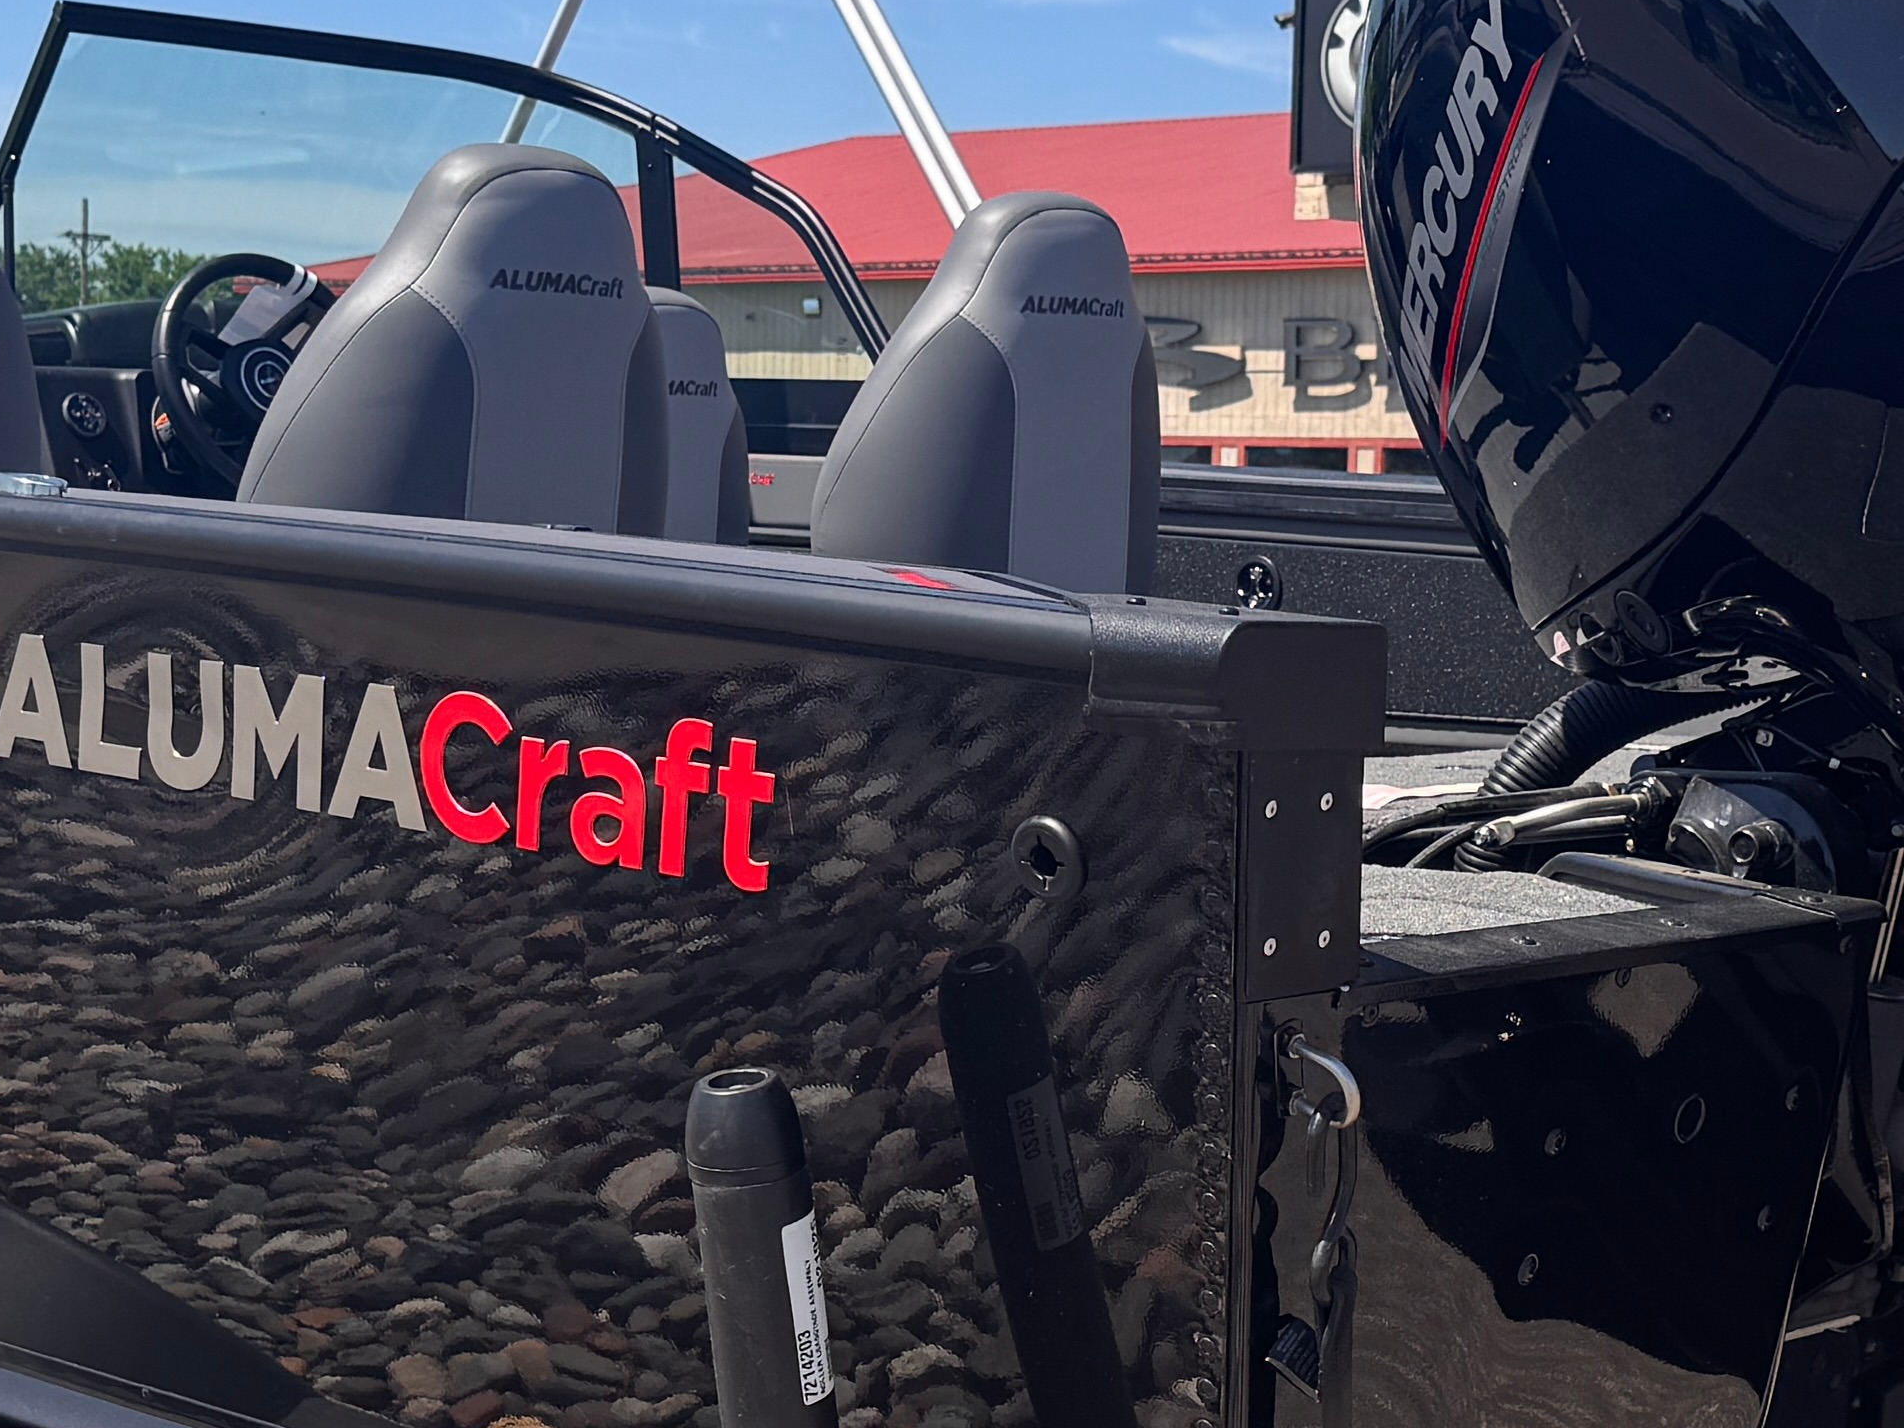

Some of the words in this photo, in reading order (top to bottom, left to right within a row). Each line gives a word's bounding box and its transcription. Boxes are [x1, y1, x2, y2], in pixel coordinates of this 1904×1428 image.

[489, 268, 624, 301] ALUMACraft
[1020, 294, 1125, 320] ALUMACraft
[797, 1329, 818, 1402] 7214203
